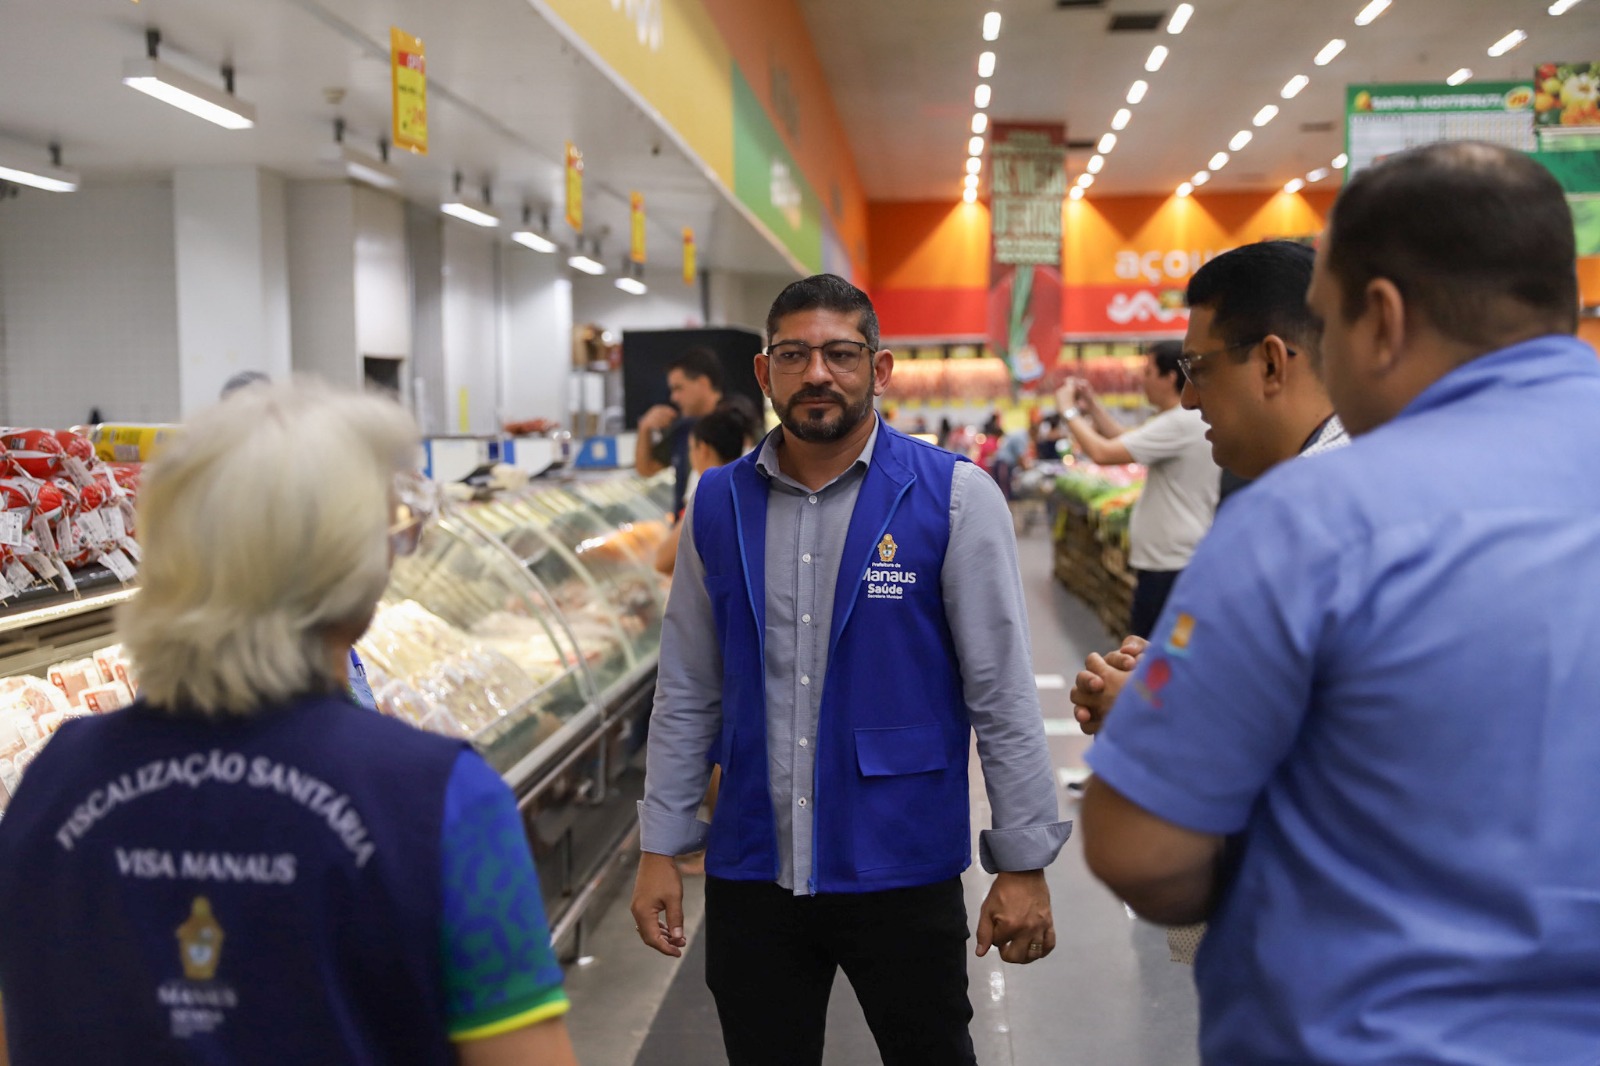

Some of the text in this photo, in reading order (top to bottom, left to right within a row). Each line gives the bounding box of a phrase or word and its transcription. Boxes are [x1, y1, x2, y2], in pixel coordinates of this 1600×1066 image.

[868, 583, 903, 594] Saúde
[55, 748, 375, 868] FISCALIZAÇÃO SANITÁRIA
[114, 848, 298, 884] VISA MANAUS
